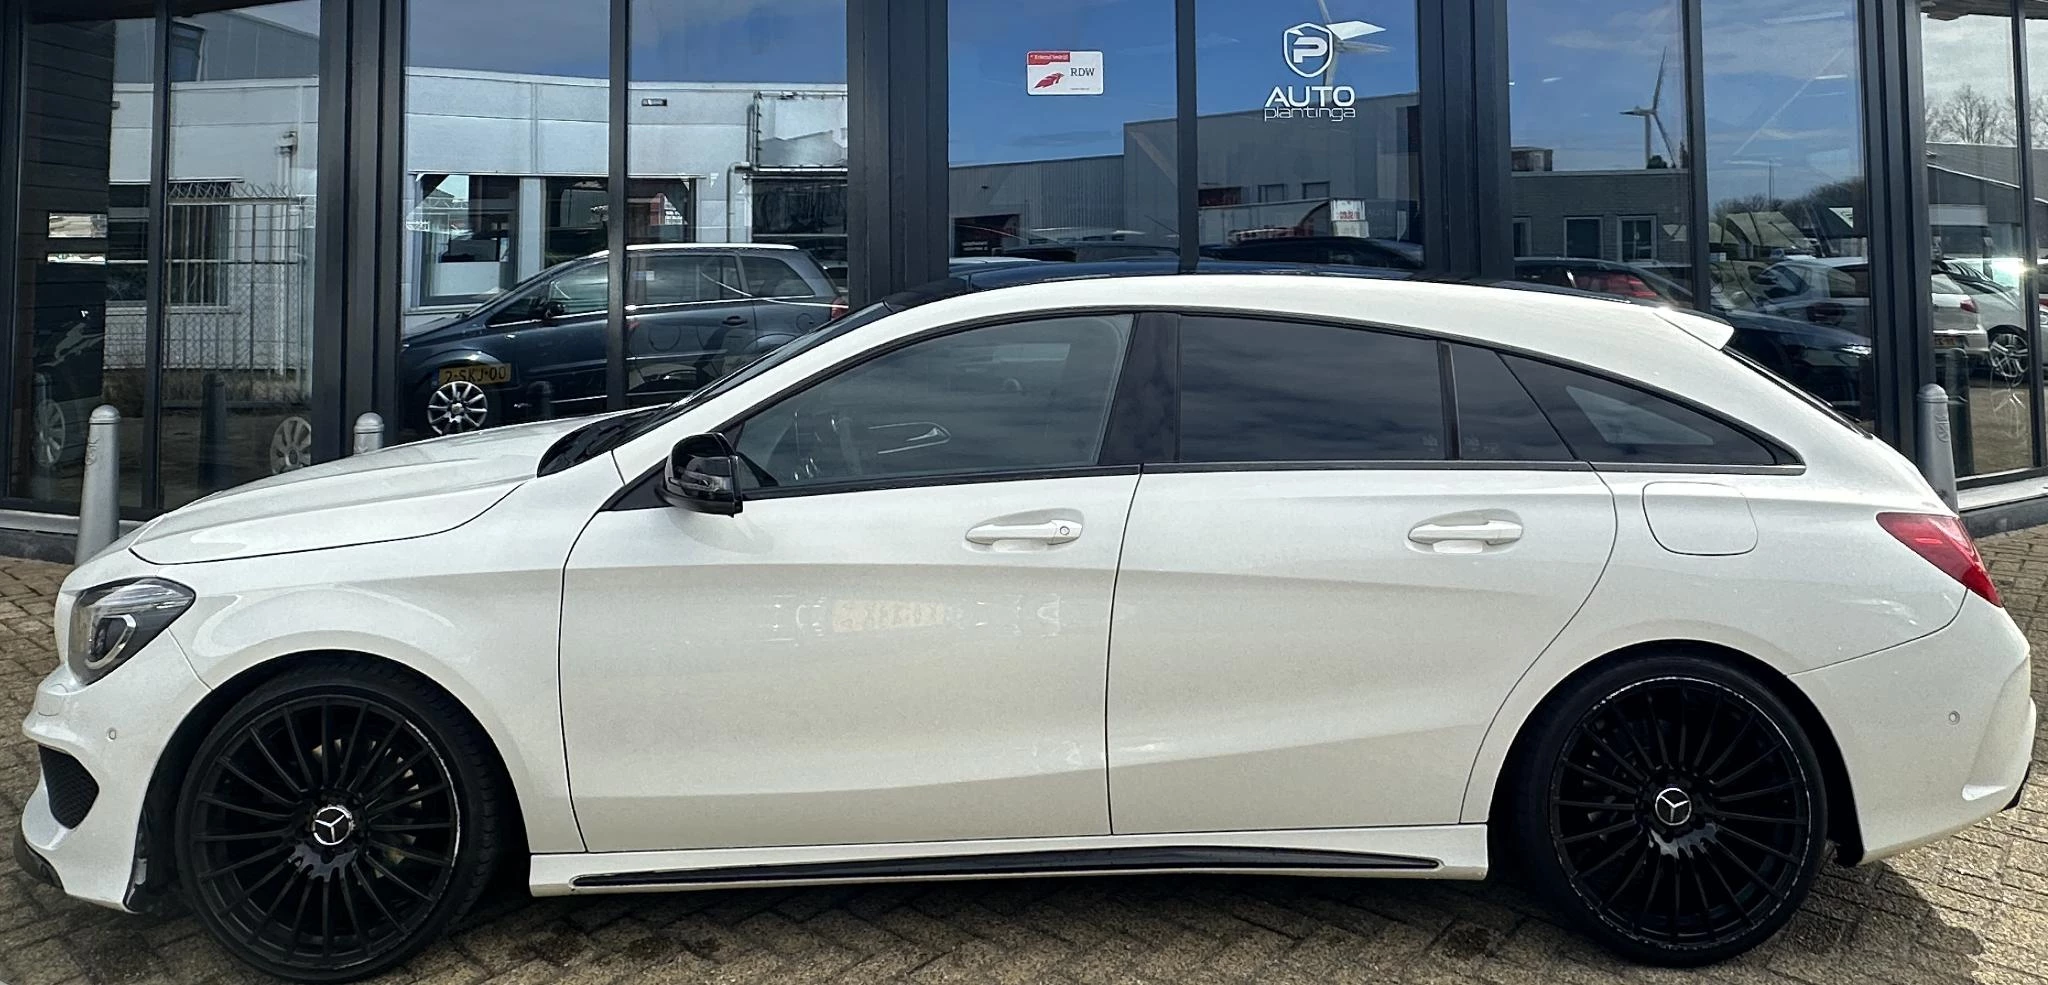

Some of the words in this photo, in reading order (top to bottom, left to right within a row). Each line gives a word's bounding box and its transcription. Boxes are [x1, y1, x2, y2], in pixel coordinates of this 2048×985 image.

[1293, 36, 1328, 63] P
[1070, 67, 1095, 77] RDW
[1264, 86, 1355, 107] AUTO
[1264, 106, 1356, 122] plantinga
